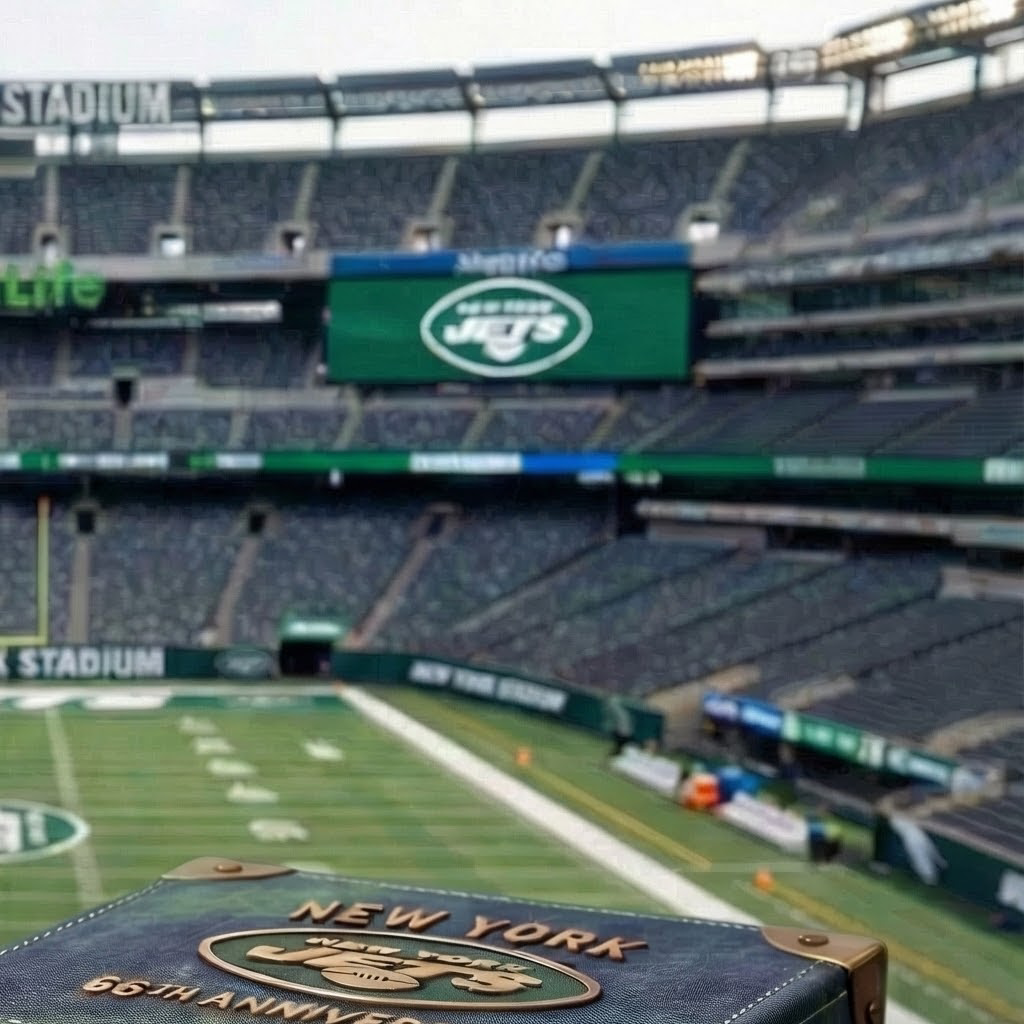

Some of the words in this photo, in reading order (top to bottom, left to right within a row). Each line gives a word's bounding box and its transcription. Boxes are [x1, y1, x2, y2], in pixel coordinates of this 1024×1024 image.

[1, 82, 171, 124] STADIUM
[17, 647, 165, 679] STADIUM
[289, 900, 451, 931] NEW
[465, 915, 649, 962] YORK
[81, 974, 200, 1002] 66TH
[245, 944, 543, 994] JETS
